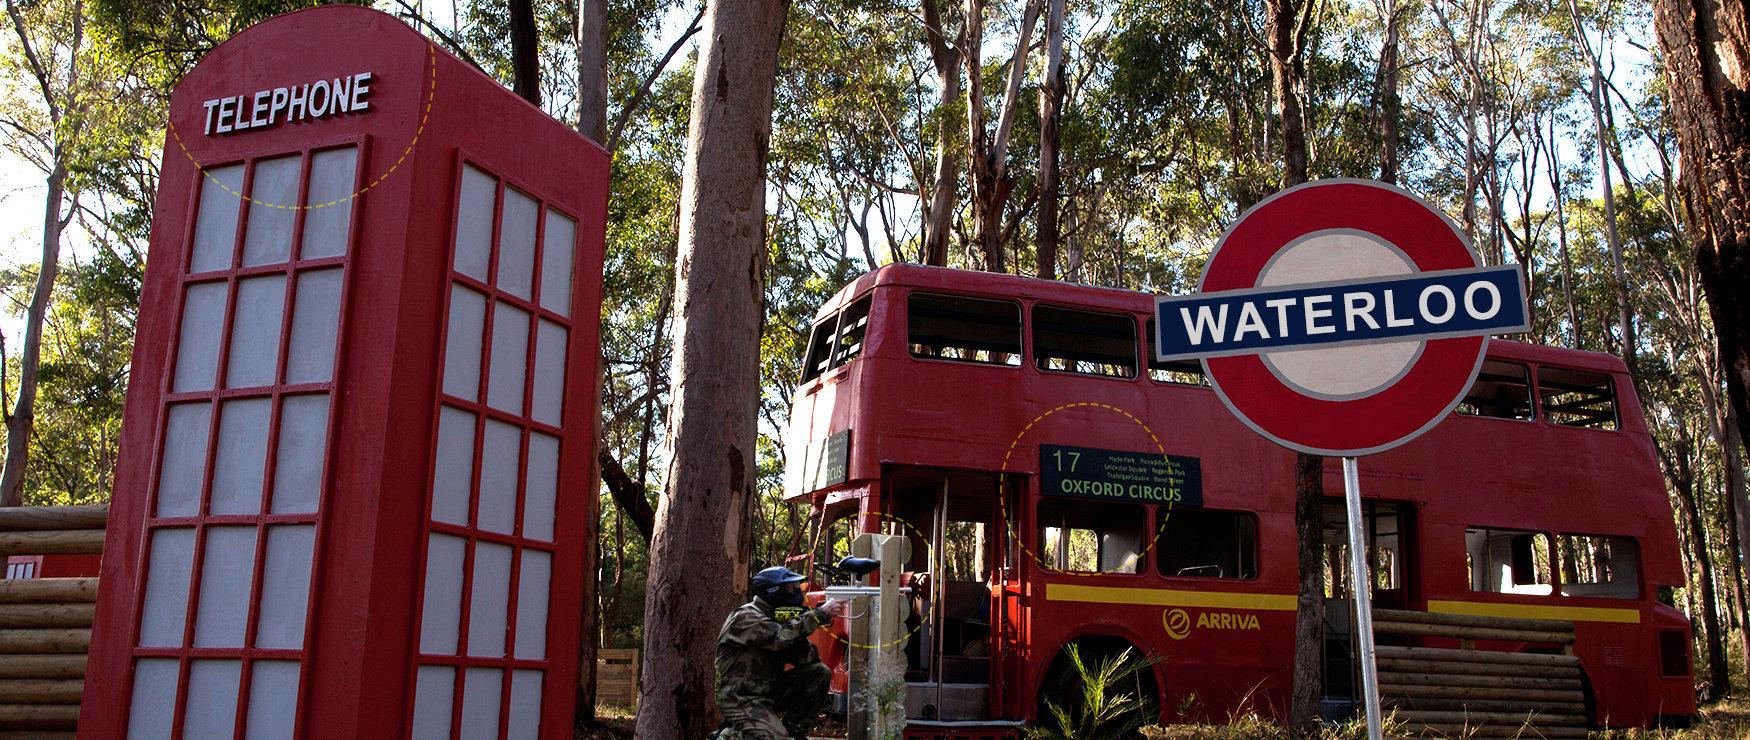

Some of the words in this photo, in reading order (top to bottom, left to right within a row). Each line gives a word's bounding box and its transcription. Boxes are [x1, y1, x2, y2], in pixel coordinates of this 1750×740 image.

[203, 72, 371, 136] TELEPHONE
[1179, 280, 1502, 346] WATERLOO
[1053, 450, 1081, 472] 17
[1104, 463, 1128, 471] Leicester
[1128, 465, 1147, 473] Square
[1108, 455, 1123, 463] Hyde
[1140, 458, 1164, 467] Piccadilly
[1107, 472, 1131, 480] Trafalgar
[1131, 474, 1149, 482] Square
[1168, 477, 1185, 485] Sreet
[1061, 478, 1124, 497] OXFORD
[1128, 484, 1182, 502] CIRCUS
[1195, 612, 1261, 631] ARRIVA
